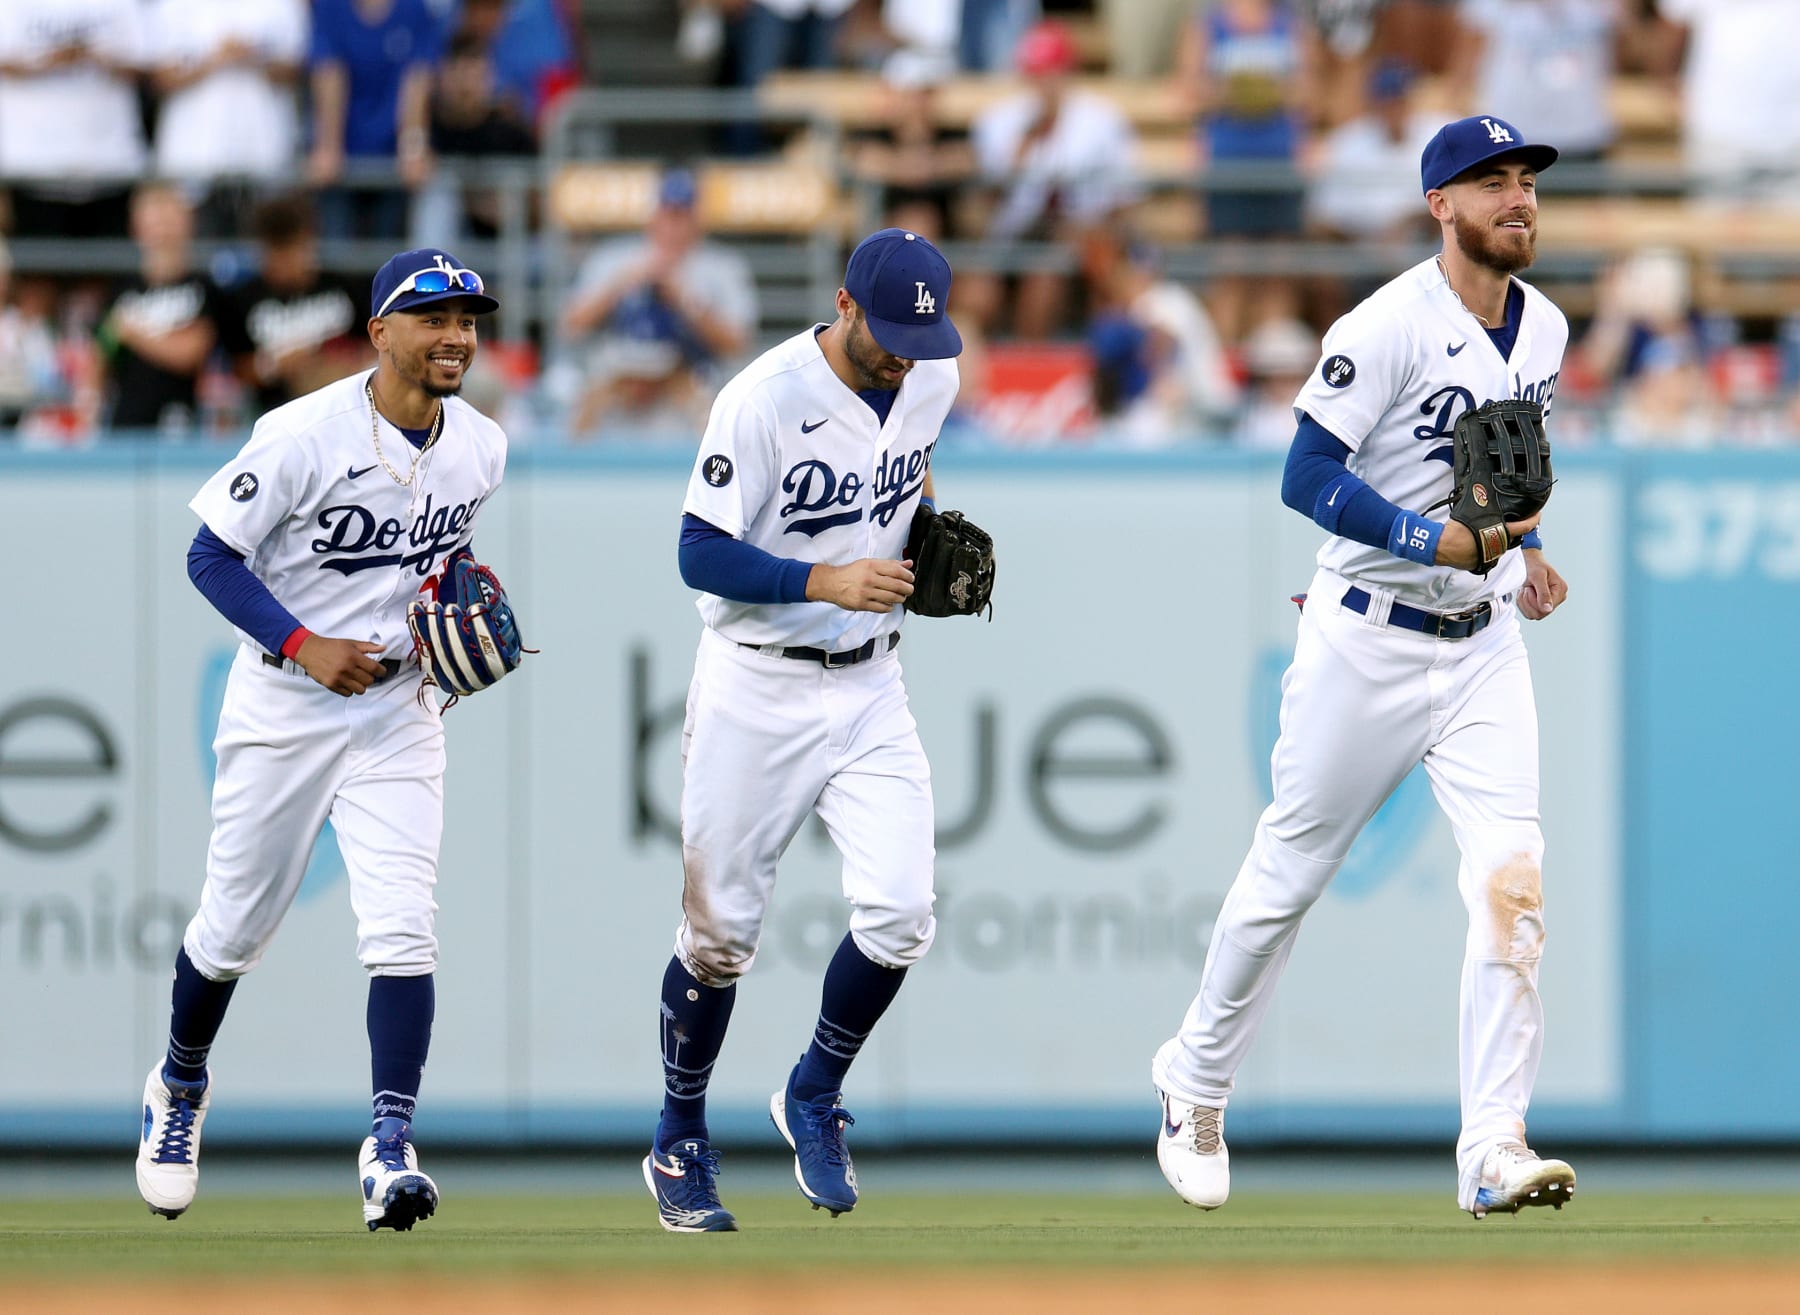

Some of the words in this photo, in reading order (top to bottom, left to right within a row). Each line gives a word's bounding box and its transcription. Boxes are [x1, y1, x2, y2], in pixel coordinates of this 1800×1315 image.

[1480, 118, 1513, 143] LA
[915, 281, 935, 313] LA
[1333, 357, 1352, 375] VIN
[712, 457, 728, 474] VIN
[240, 473, 257, 492] VIN
[780, 441, 934, 532] Dodger
[312, 493, 478, 576] Dodger
[628, 648, 1173, 854] bue
